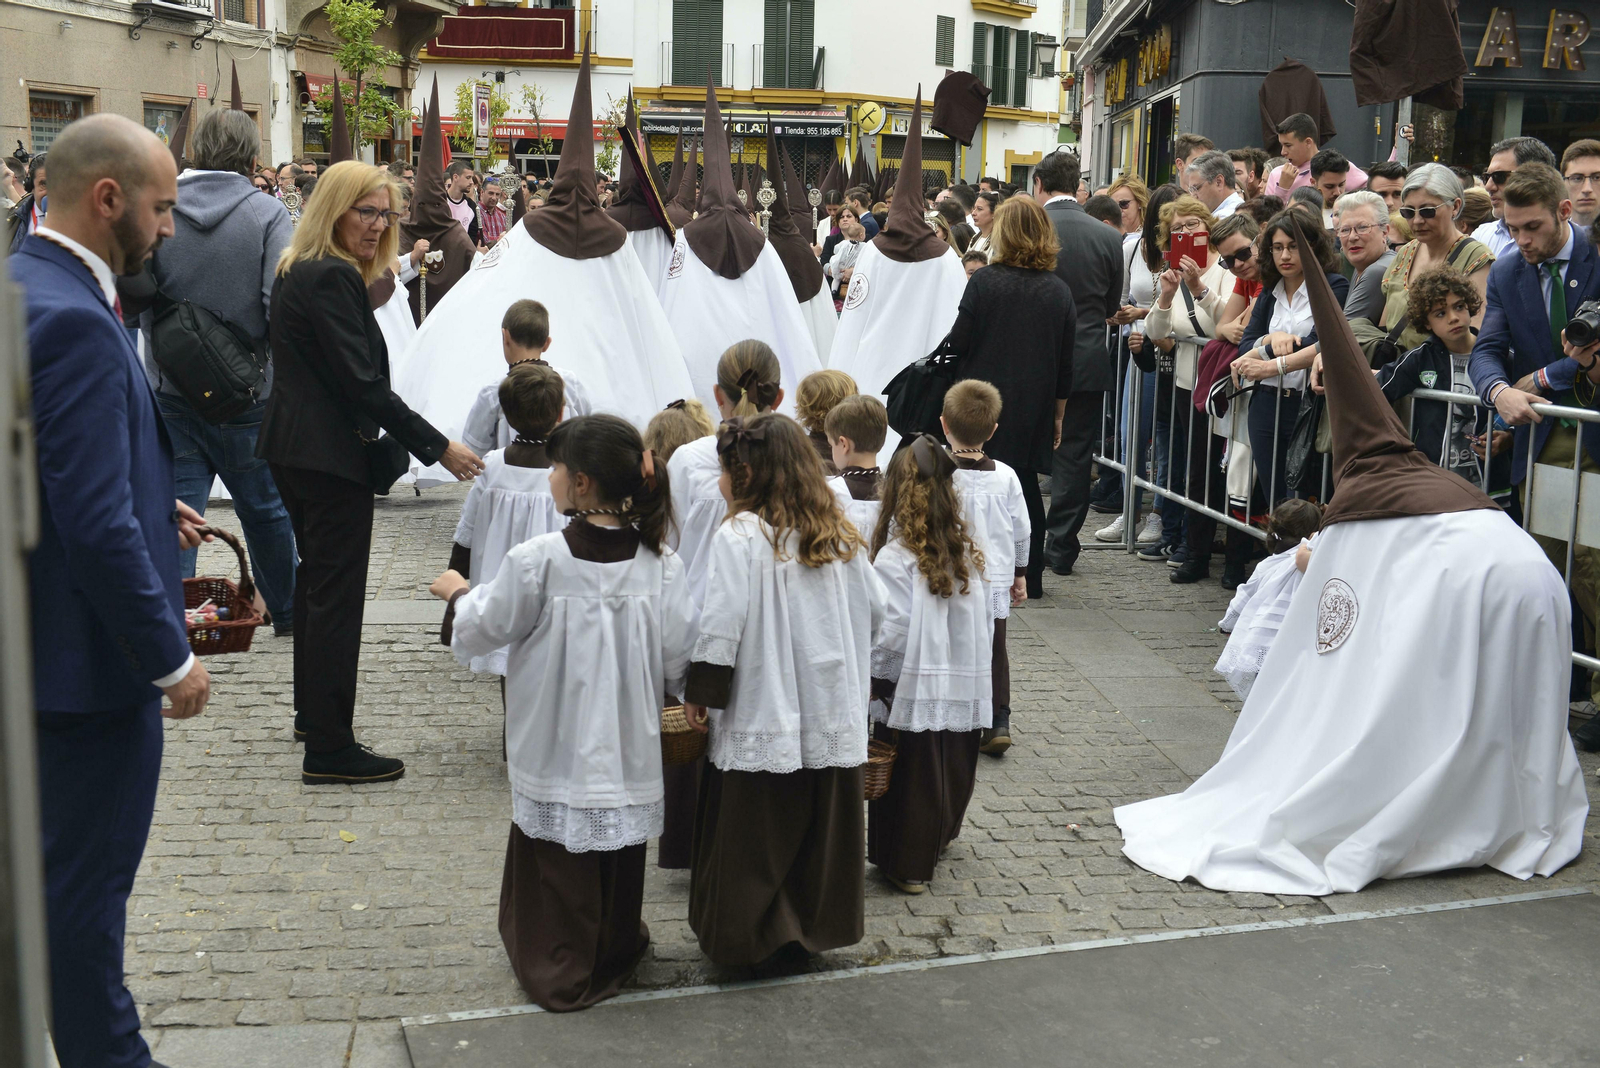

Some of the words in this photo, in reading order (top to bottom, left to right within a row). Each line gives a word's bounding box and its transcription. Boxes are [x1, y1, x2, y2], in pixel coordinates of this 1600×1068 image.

[785, 126, 806, 135] Tienda:
[807, 127, 818, 135] 955
[820, 127, 831, 136] 185
